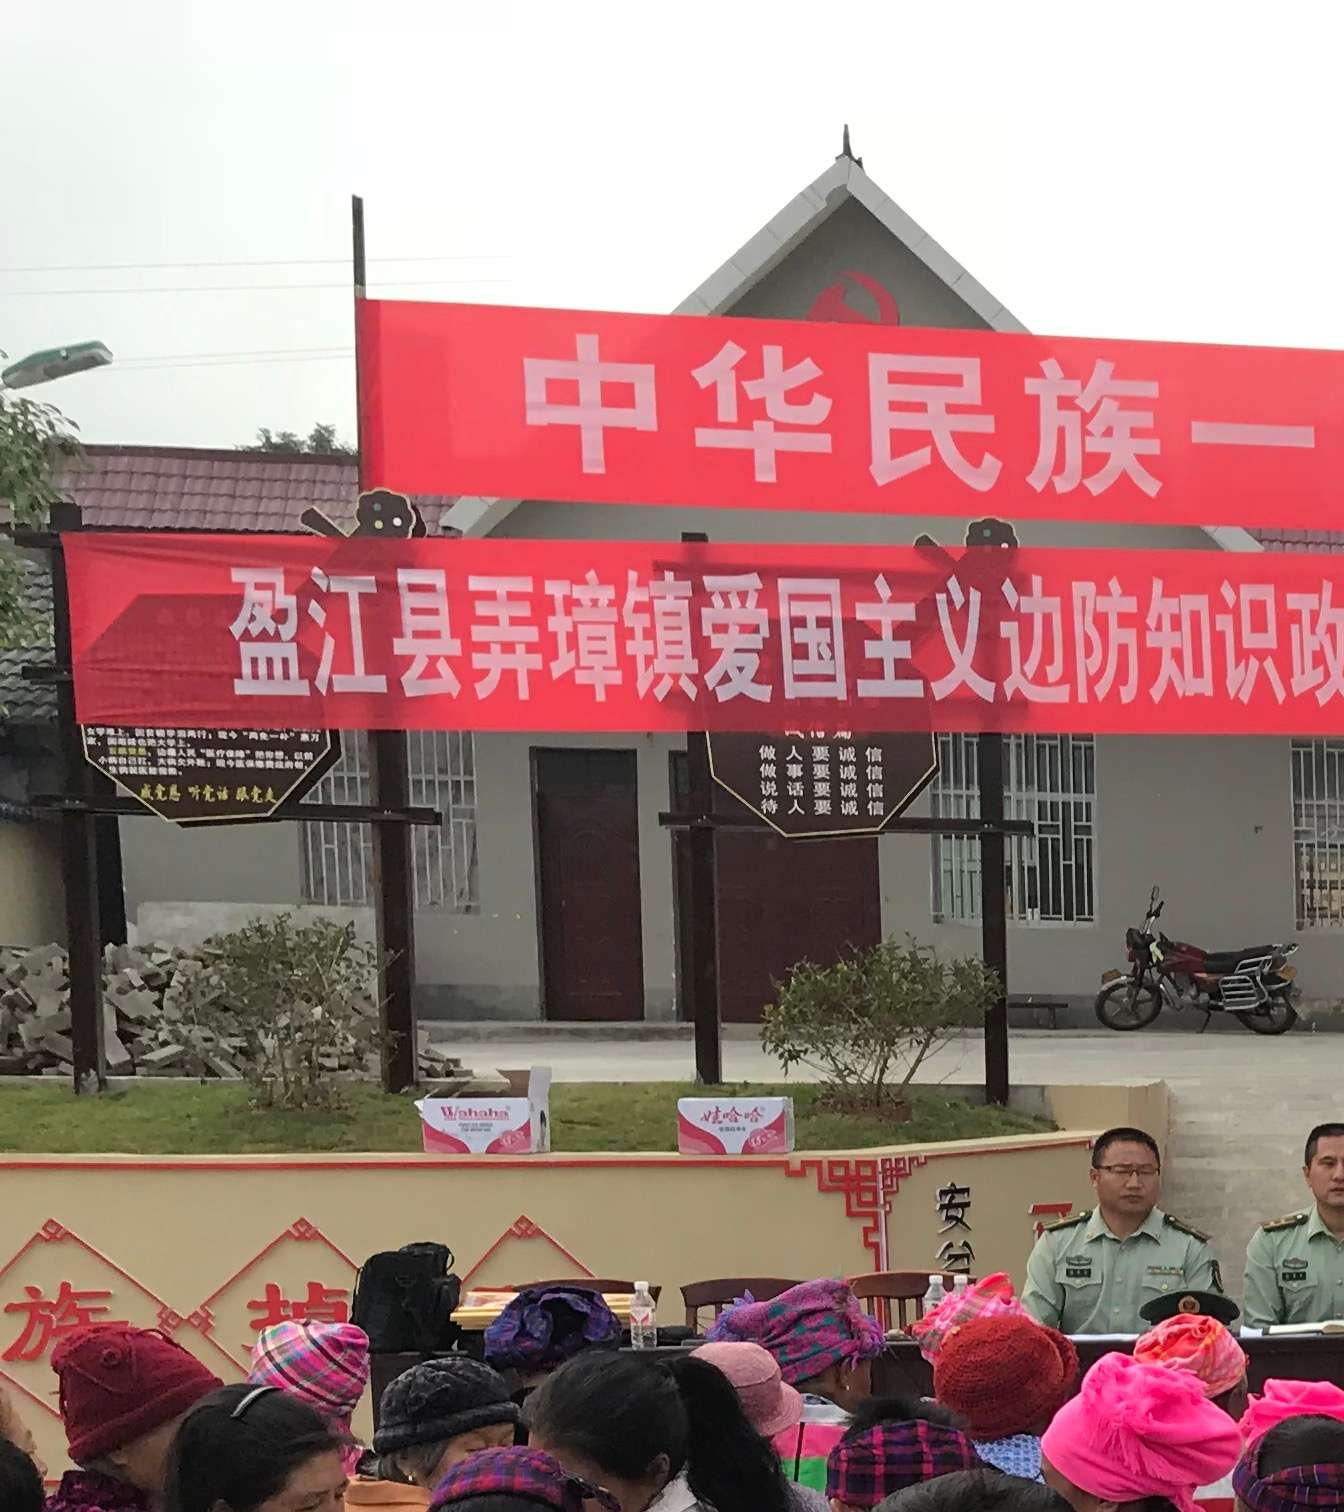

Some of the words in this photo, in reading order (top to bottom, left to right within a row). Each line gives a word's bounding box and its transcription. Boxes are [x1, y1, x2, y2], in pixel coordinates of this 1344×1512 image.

[440, 1105, 509, 1119] Wahaha
[700, 1105, 763, 1124] 娃哈哈
